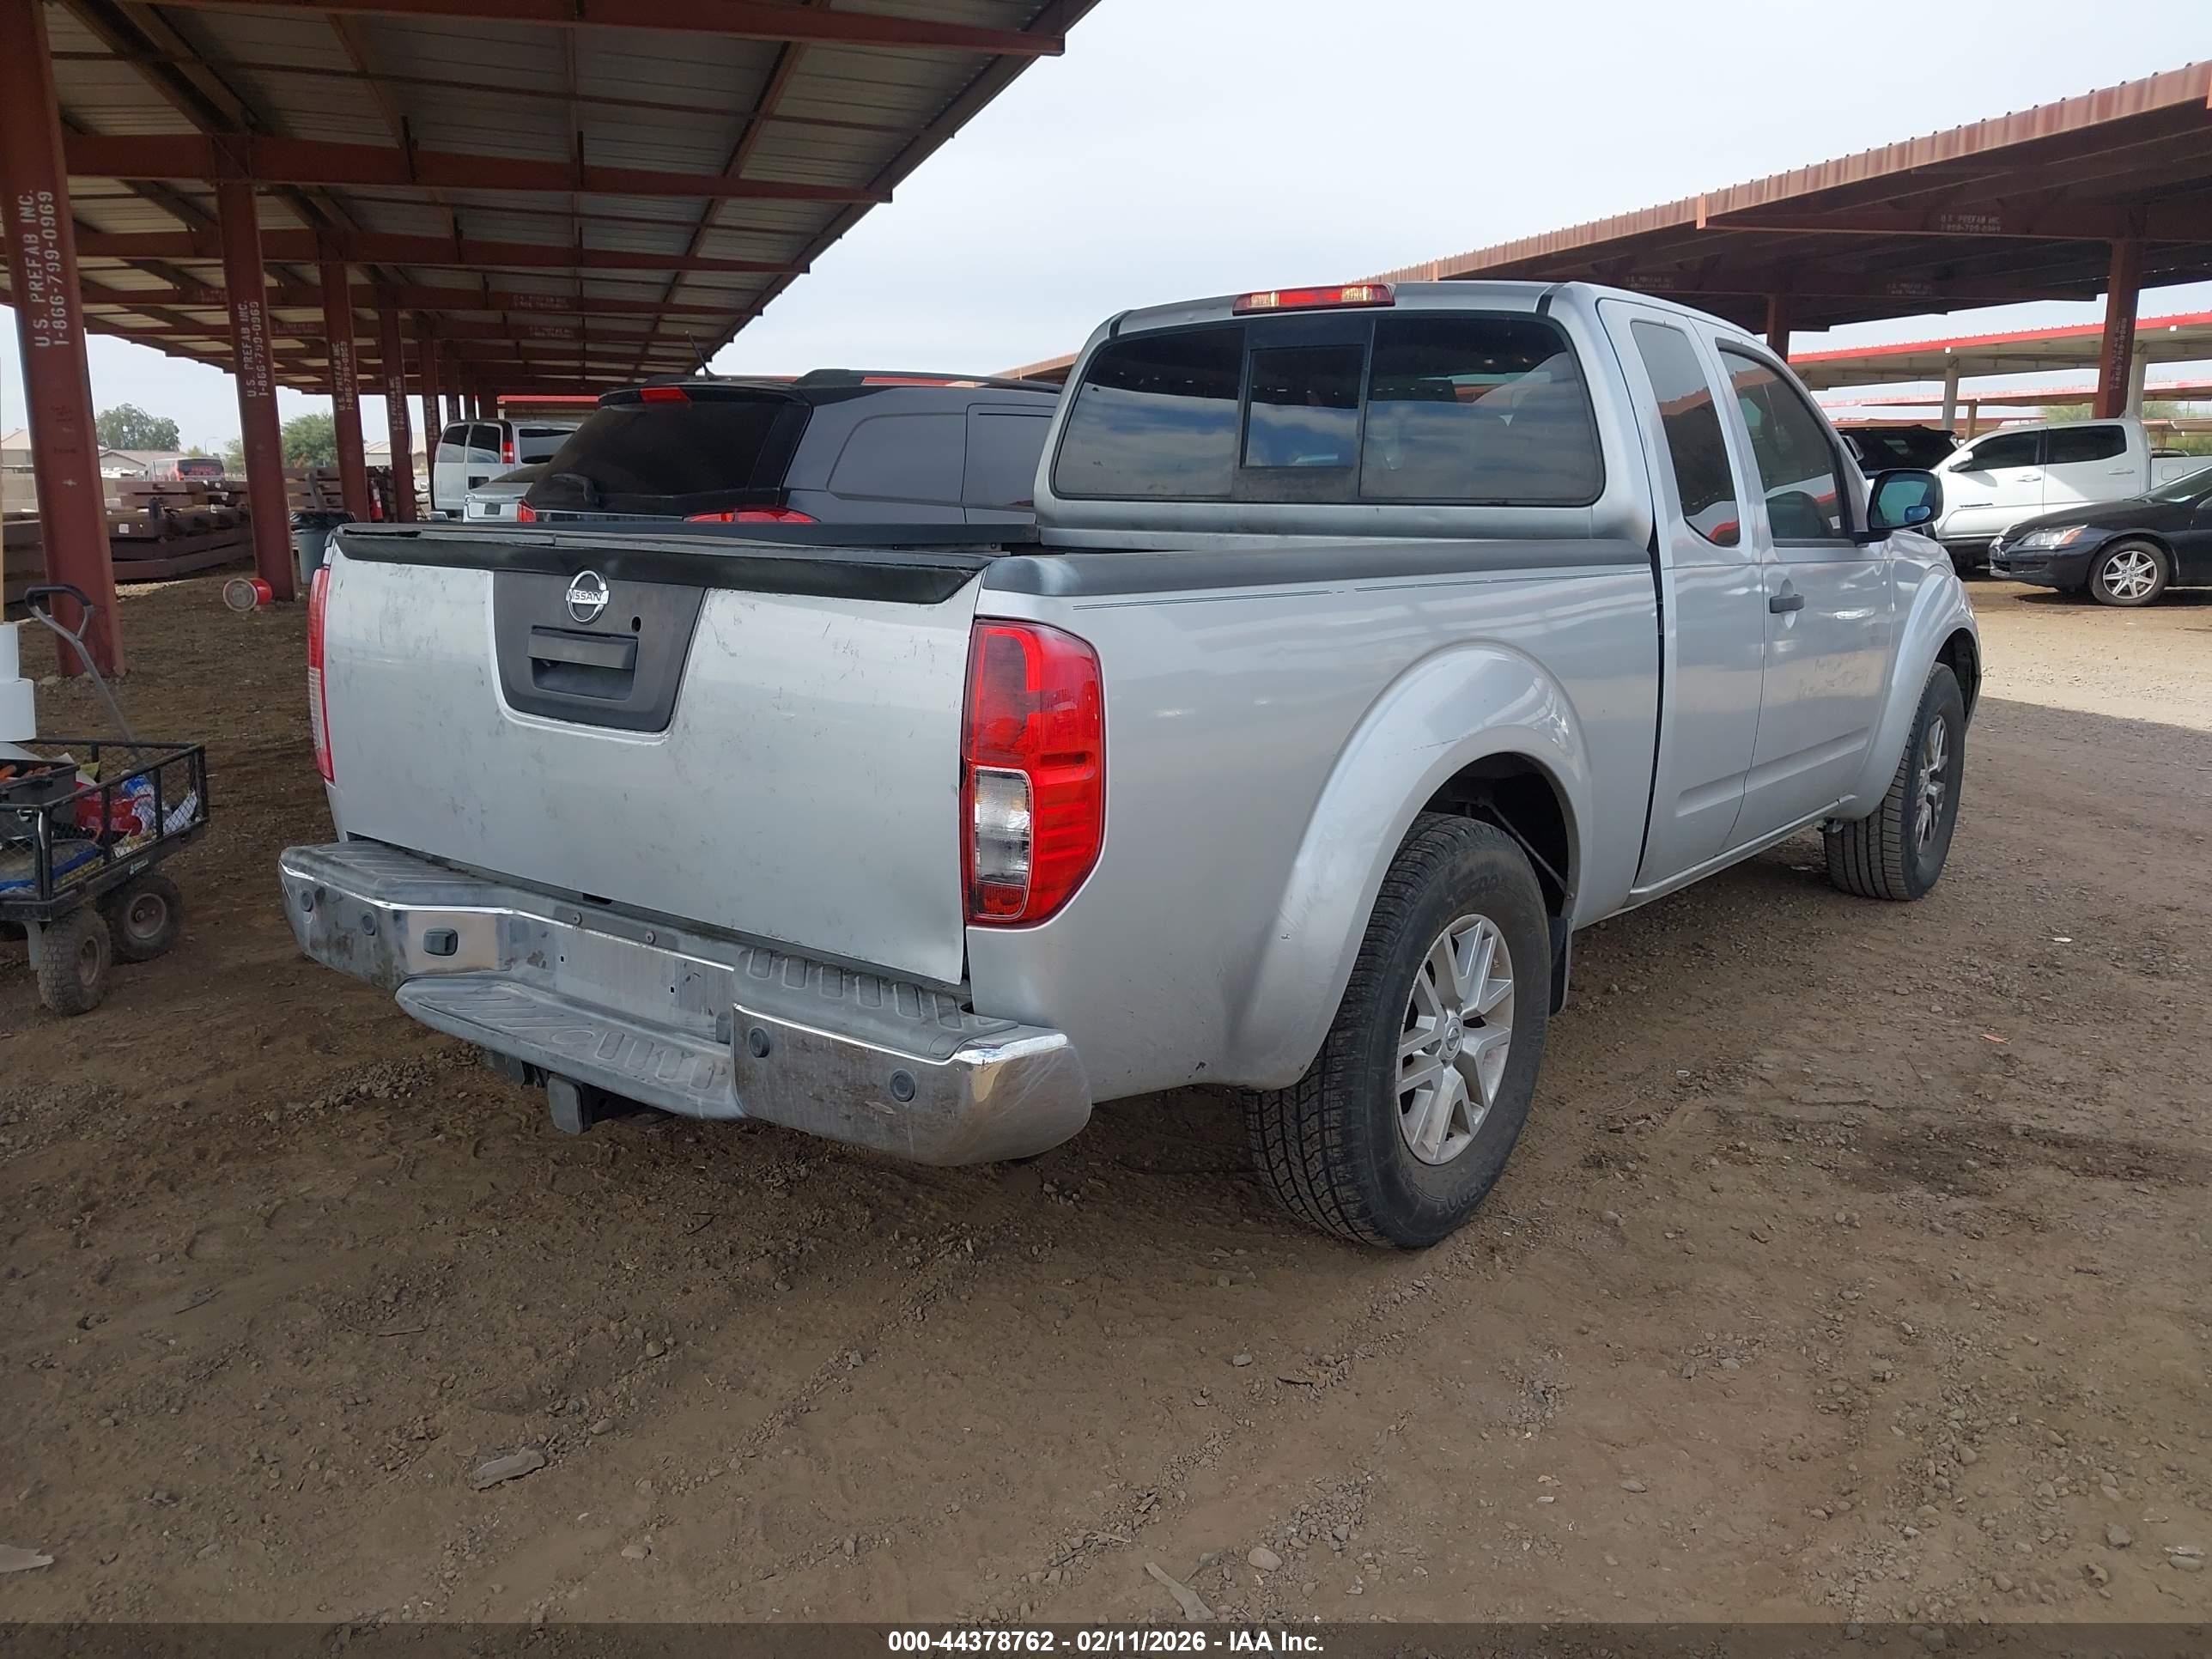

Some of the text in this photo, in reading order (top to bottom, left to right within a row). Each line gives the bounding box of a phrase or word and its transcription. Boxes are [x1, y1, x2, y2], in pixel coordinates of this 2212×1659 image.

[17, 189, 51, 347] U.S. PREFAB INC.
[37, 191, 70, 345] 1-866-799-0969
[240, 327, 254, 370] PREFAB
[246, 376, 257, 398] U.S.
[568, 589, 602, 602] NISSAN
